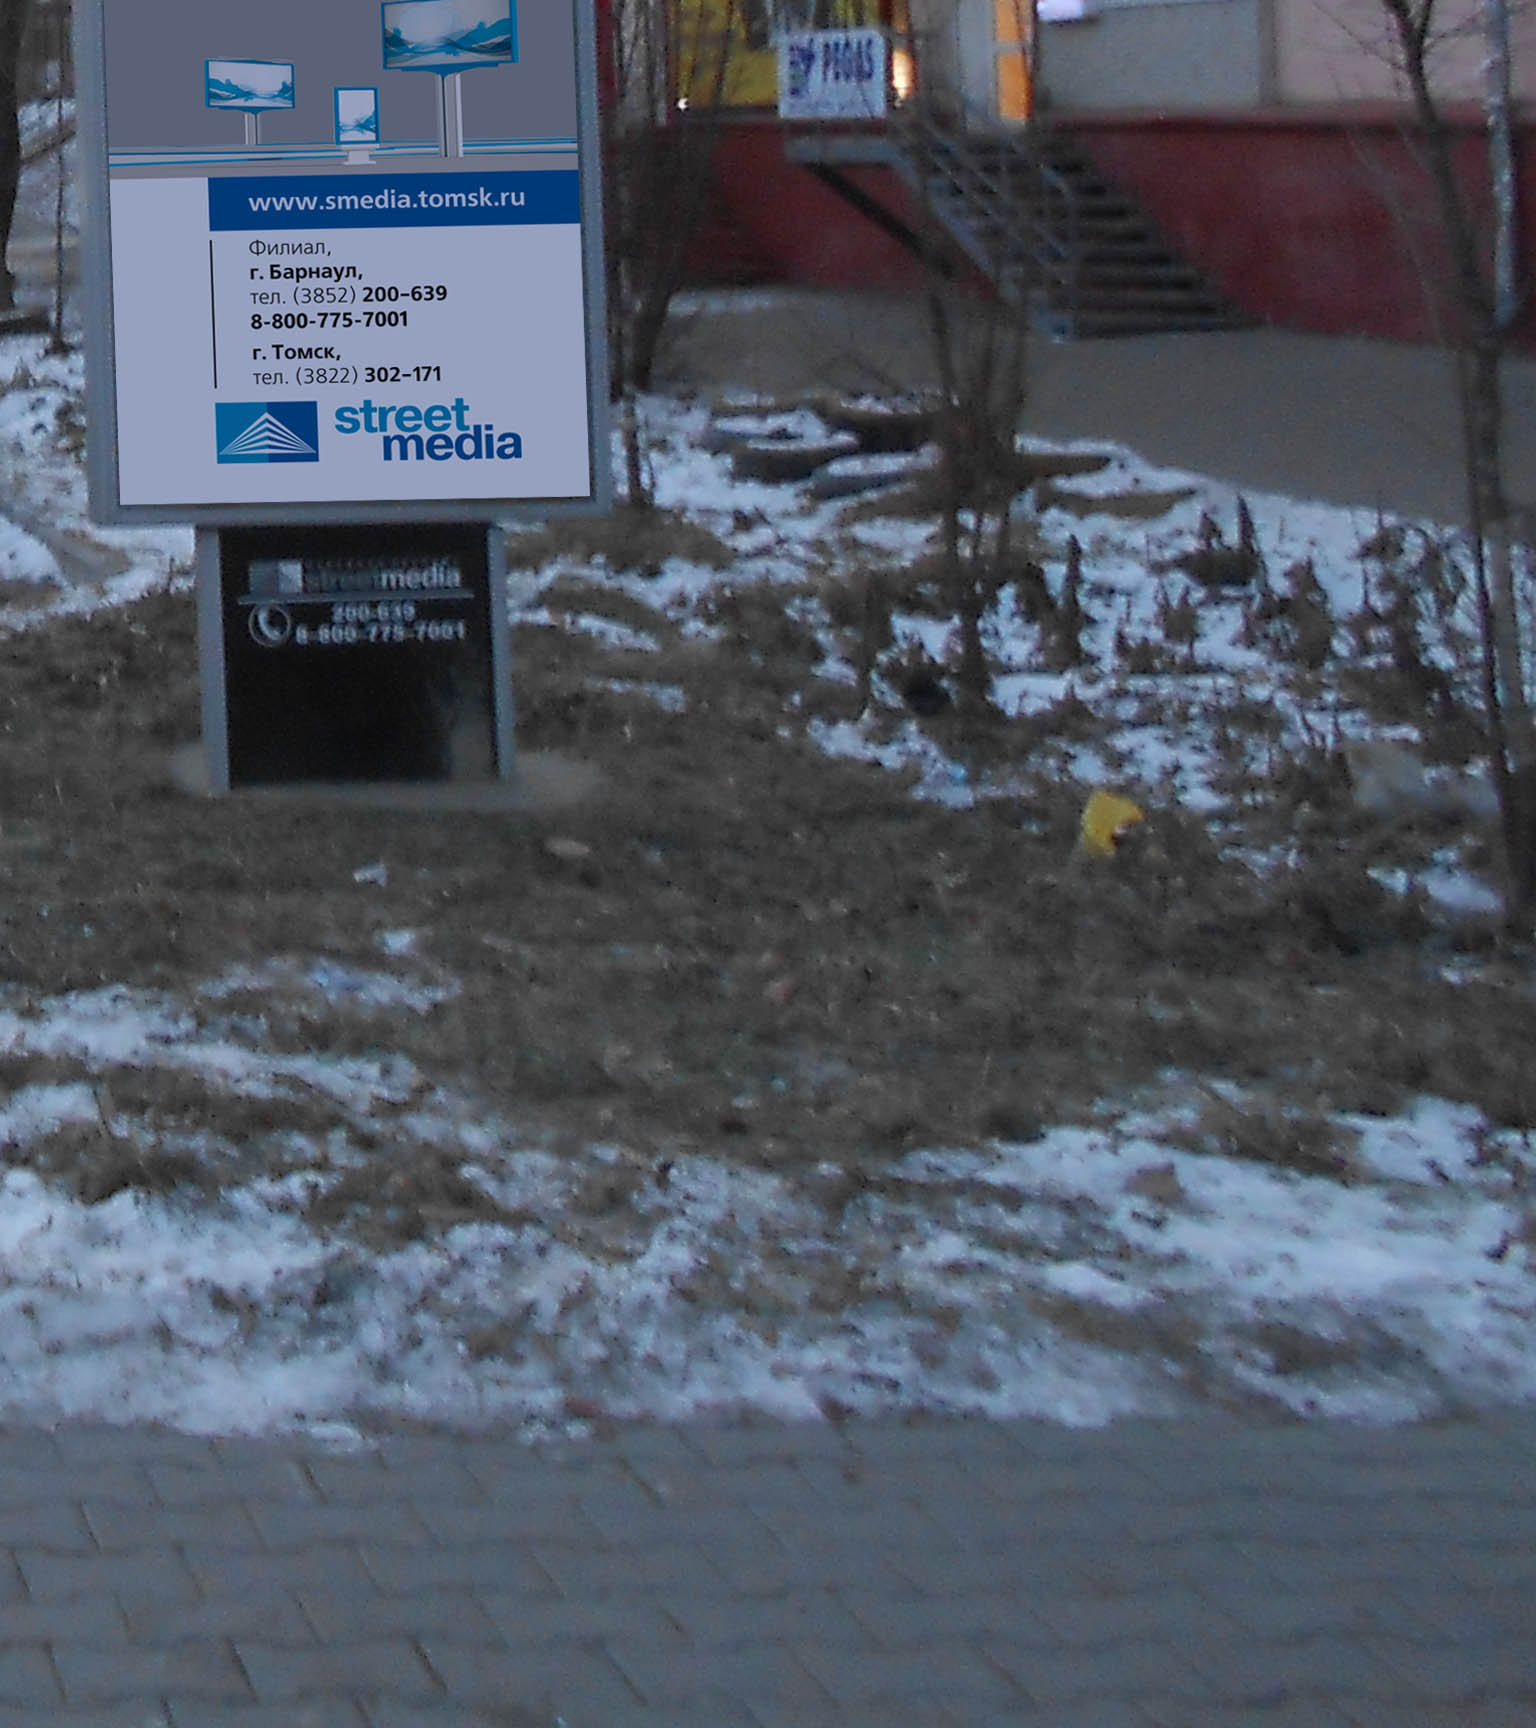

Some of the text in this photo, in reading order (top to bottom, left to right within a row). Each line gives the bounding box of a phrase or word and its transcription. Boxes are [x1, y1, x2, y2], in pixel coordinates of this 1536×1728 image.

[248, 187, 526, 212] www.smedia.tomsk.ru
[248, 240, 332, 257] Филиал,
[249, 264, 364, 283] г. Барнаул,
[250, 285, 448, 306] тел. (3852) 200-639
[250, 310, 409, 330] 8-800-775-7001
[252, 344, 342, 362] г. Томск,
[253, 365, 443, 387] тел. (3822) 302-171
[335, 397, 471, 435] street
[383, 424, 523, 461] media
